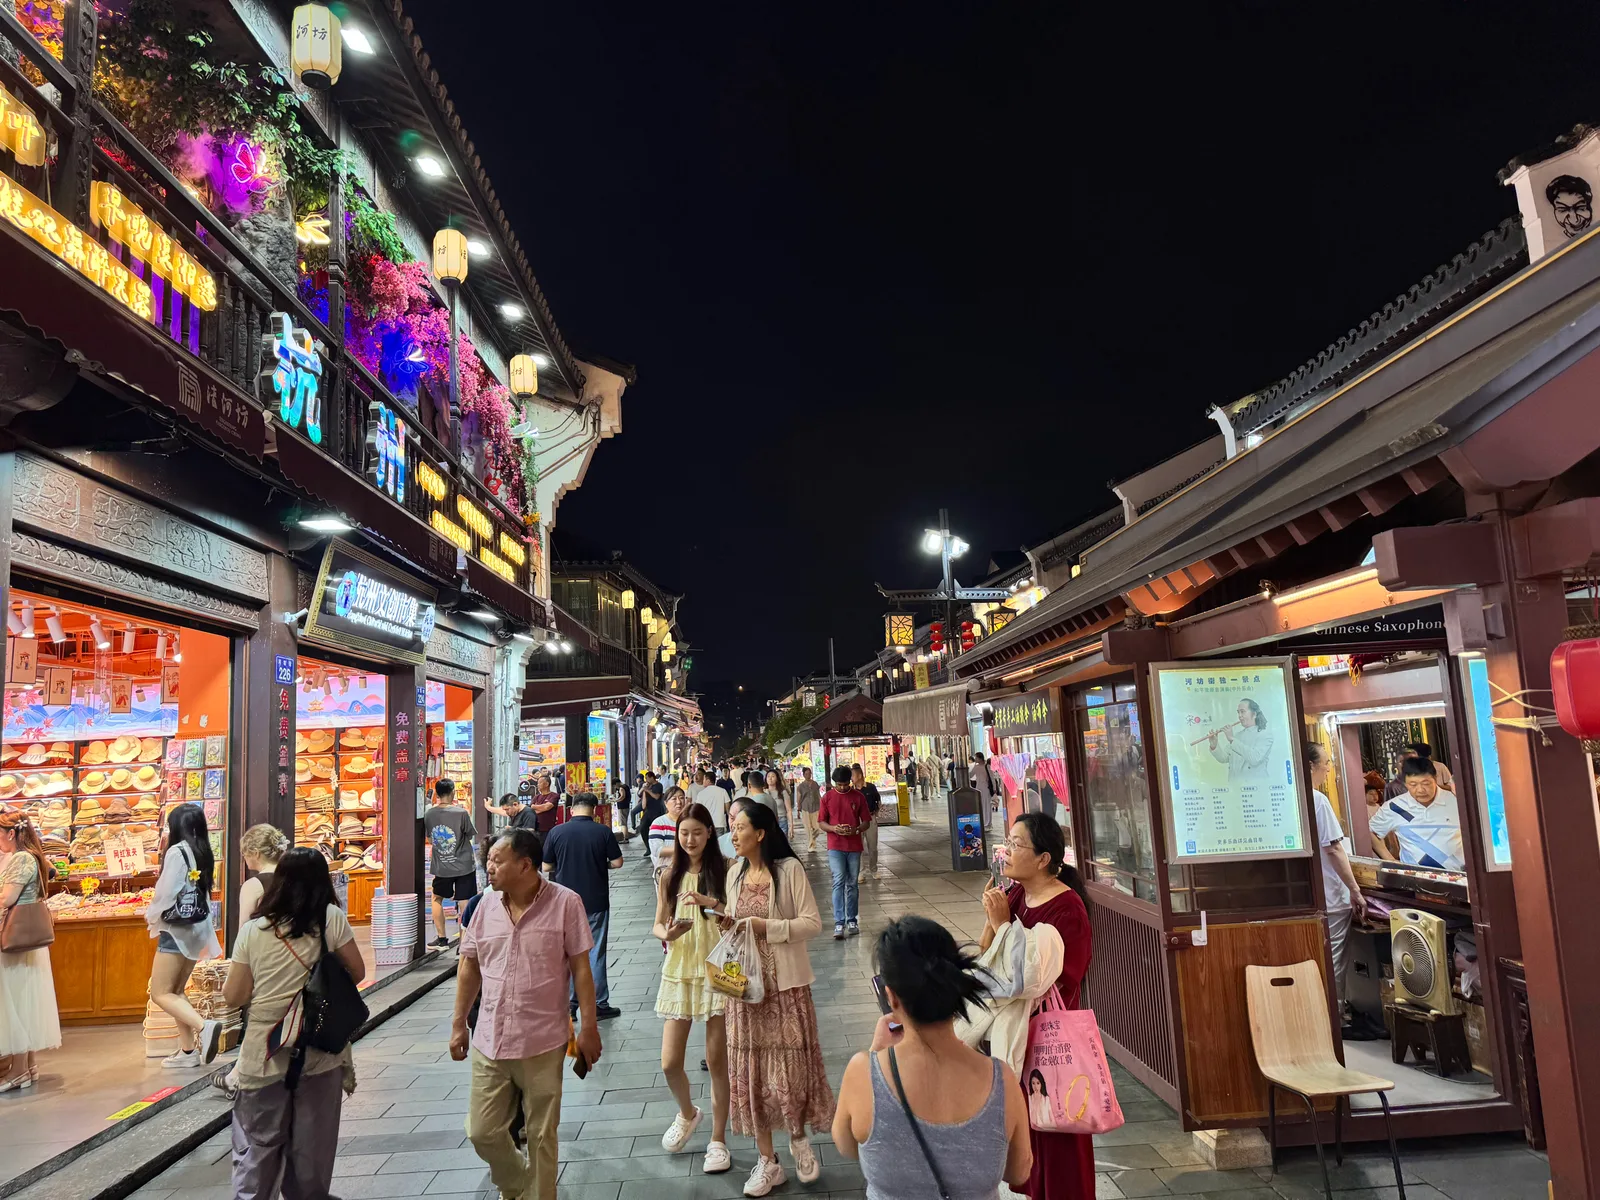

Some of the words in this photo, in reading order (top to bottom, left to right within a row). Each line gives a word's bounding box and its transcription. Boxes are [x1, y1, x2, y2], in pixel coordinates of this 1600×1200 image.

[296, 23, 328, 41] 河坊
[206, 384, 249, 429] 清河坊
[272, 312, 407, 503] 杭州
[1374, 619, 1446, 633] Saxophon
[279, 667, 291, 681] 226
[394, 711, 410, 782] 免费盖章
[113, 847, 137, 858] 网红发夹
